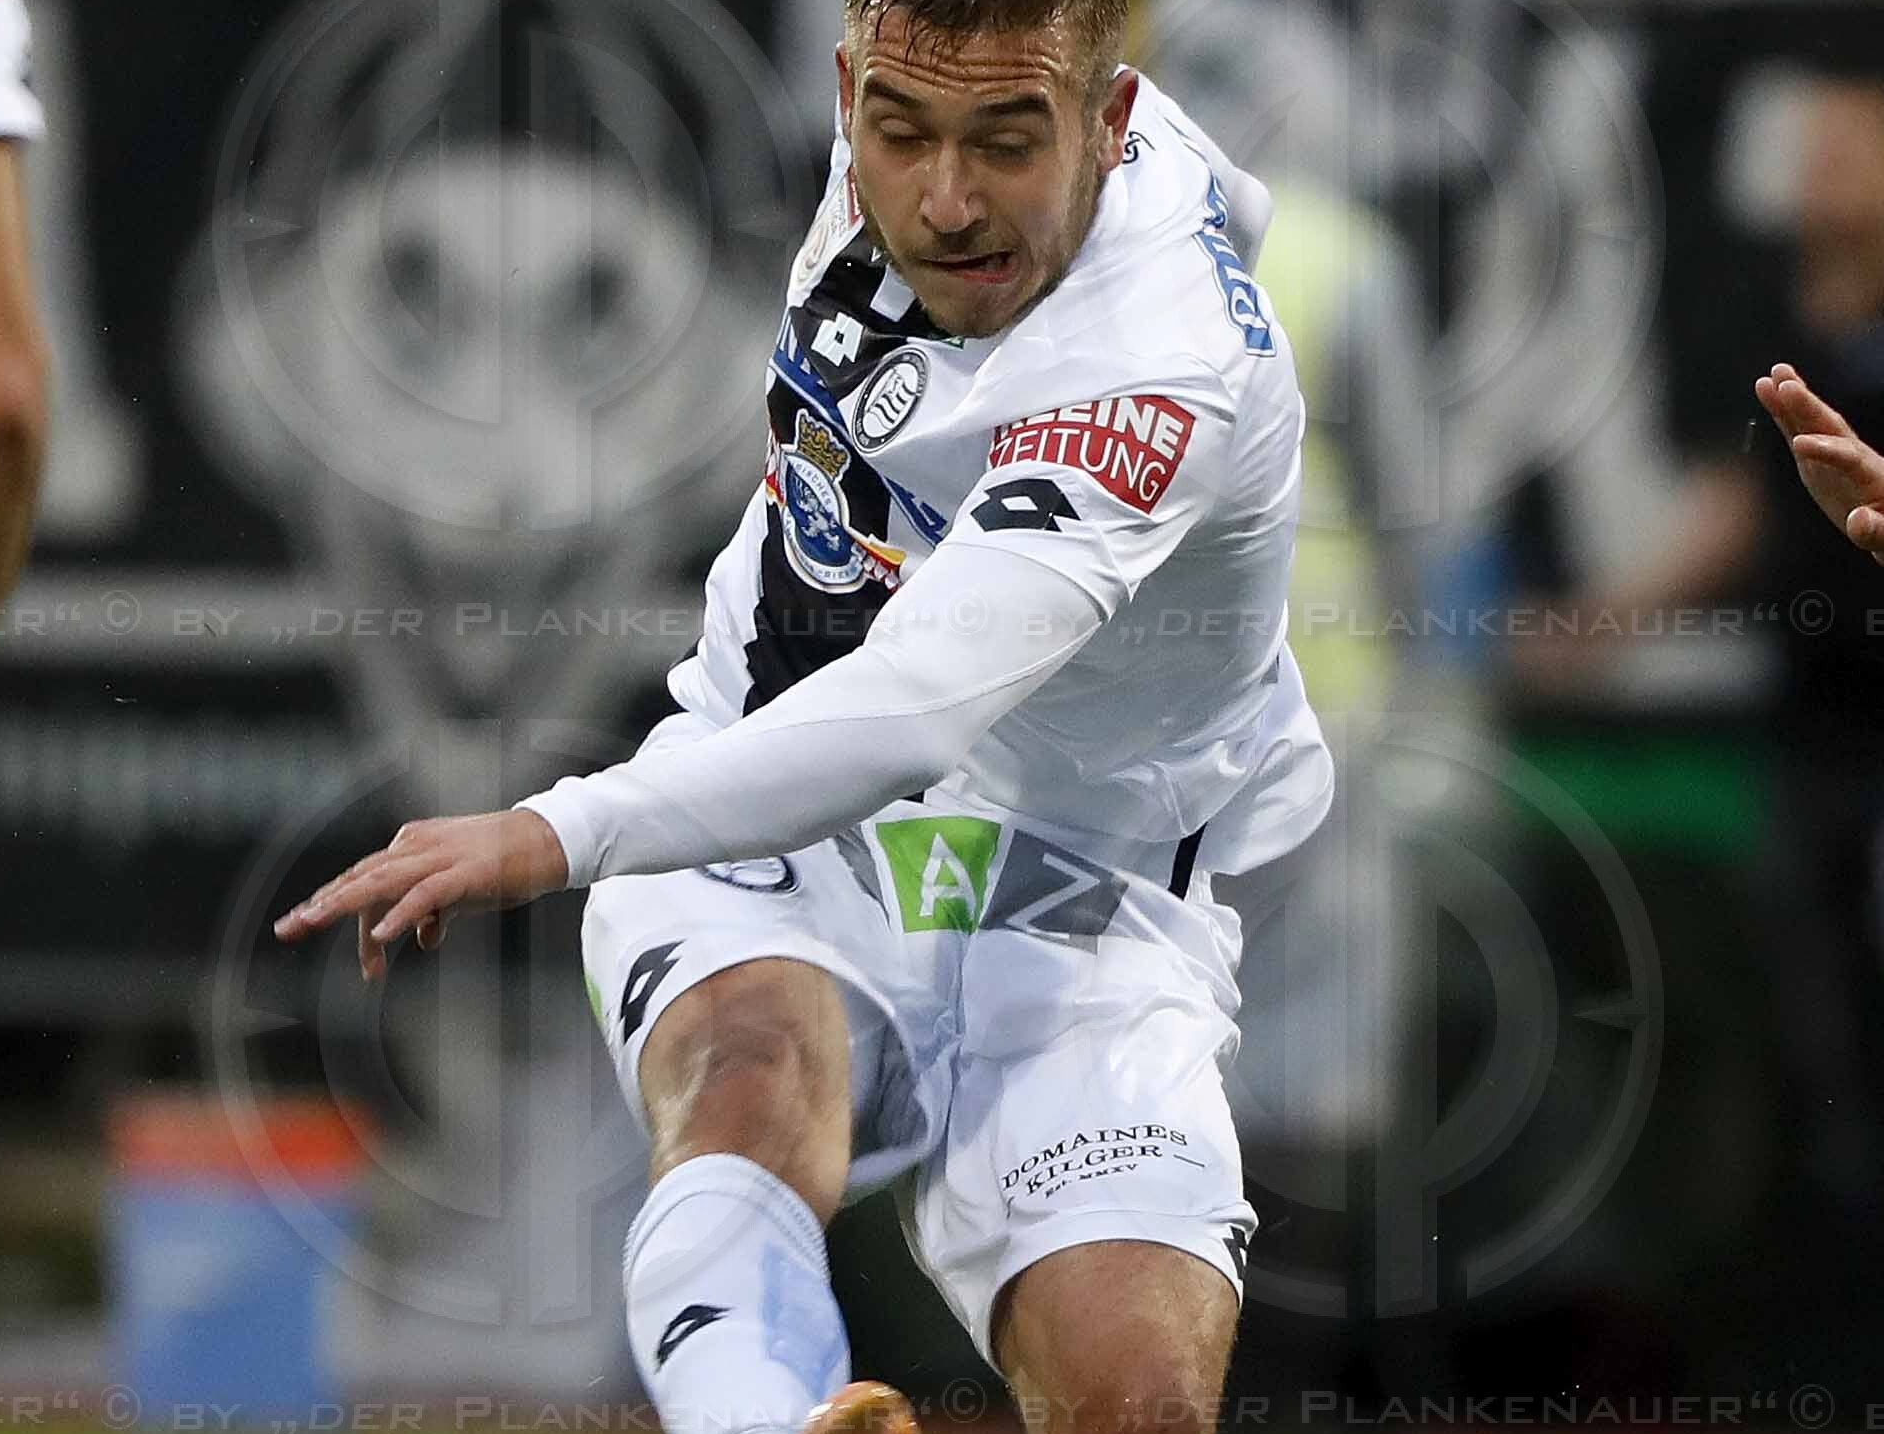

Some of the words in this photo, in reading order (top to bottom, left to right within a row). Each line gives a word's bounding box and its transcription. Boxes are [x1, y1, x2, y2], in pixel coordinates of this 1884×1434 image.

[994, 426, 1168, 503] ZEITUNG
[1001, 1124, 1188, 1191] DOMAINES
[1025, 1144, 1163, 1197] KILGER
